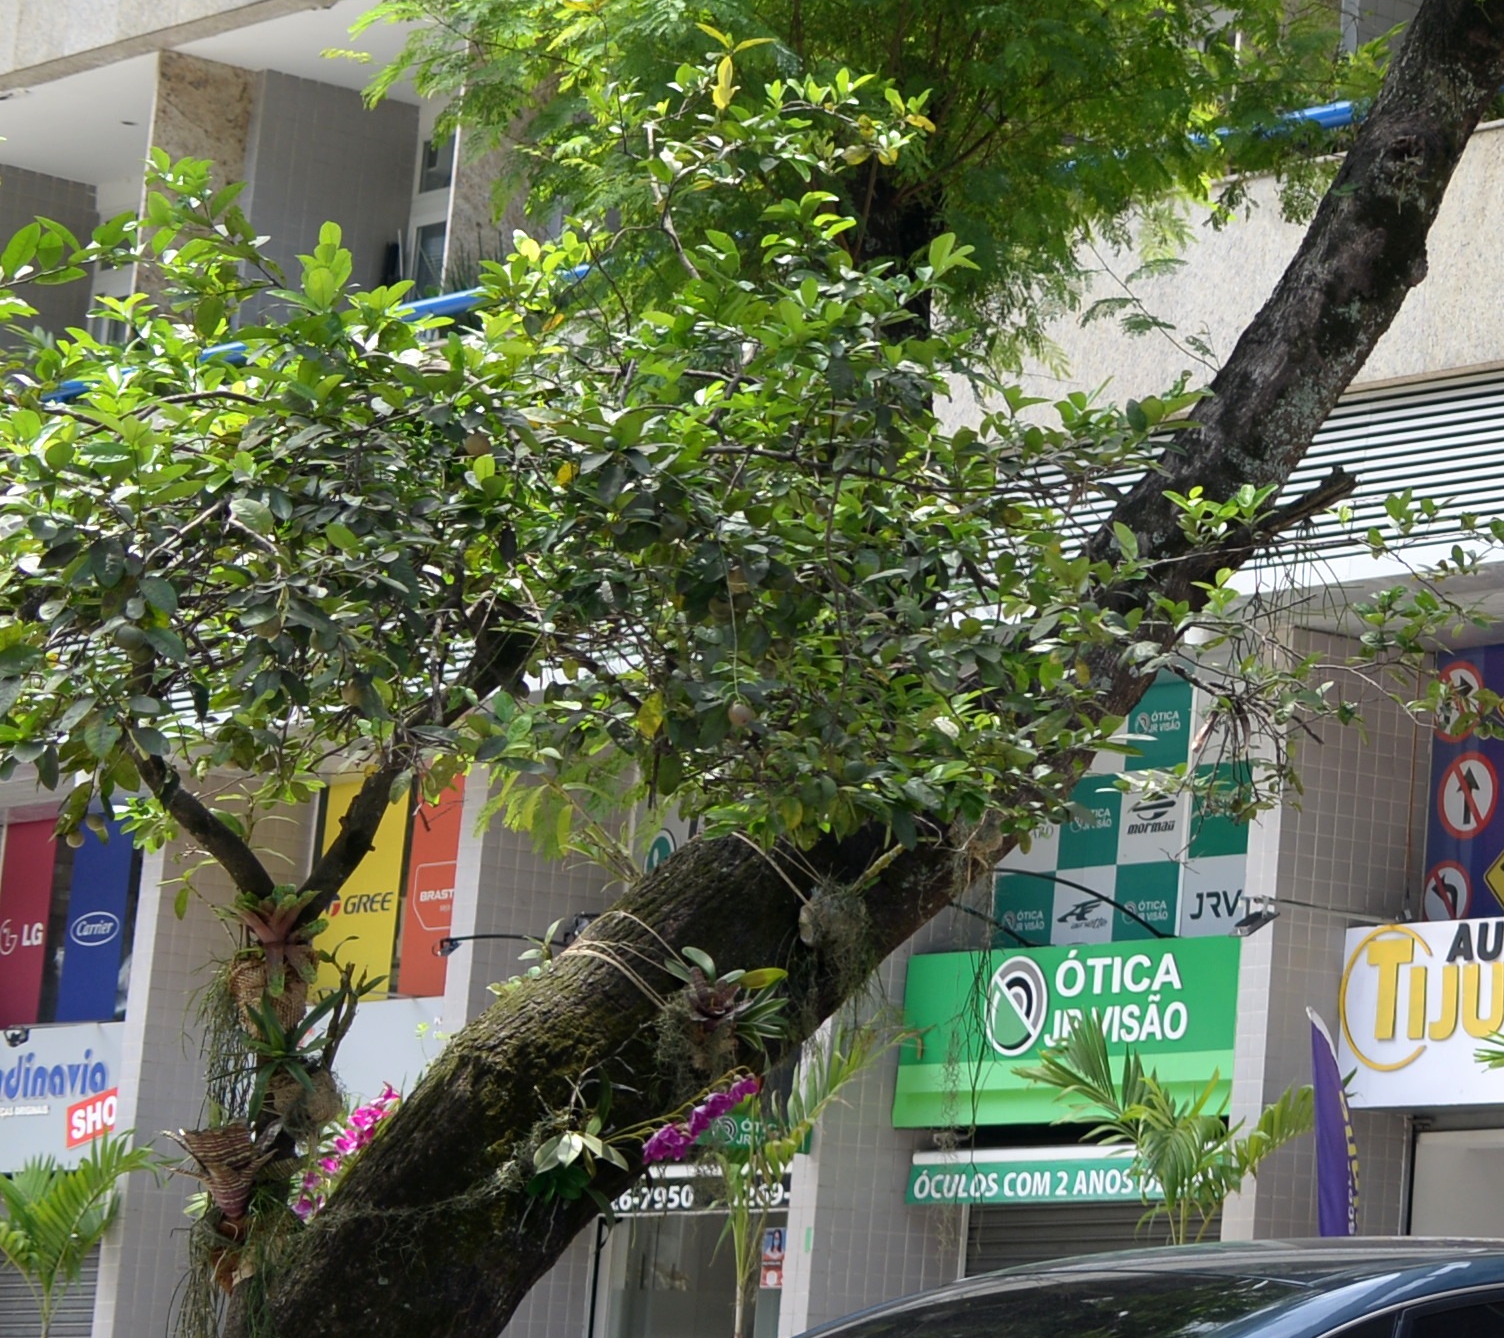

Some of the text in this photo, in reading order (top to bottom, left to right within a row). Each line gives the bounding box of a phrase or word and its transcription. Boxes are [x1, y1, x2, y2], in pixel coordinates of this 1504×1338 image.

[1151, 709, 1180, 721] ÓTICA
[343, 892, 394, 914] GREE
[22, 921, 43, 947] LG
[75, 918, 114, 937] Carrier
[1055, 950, 1183, 997] ÓTICA
[913, 1168, 1132, 1200] ÓCULOS COM 2 ANOS
